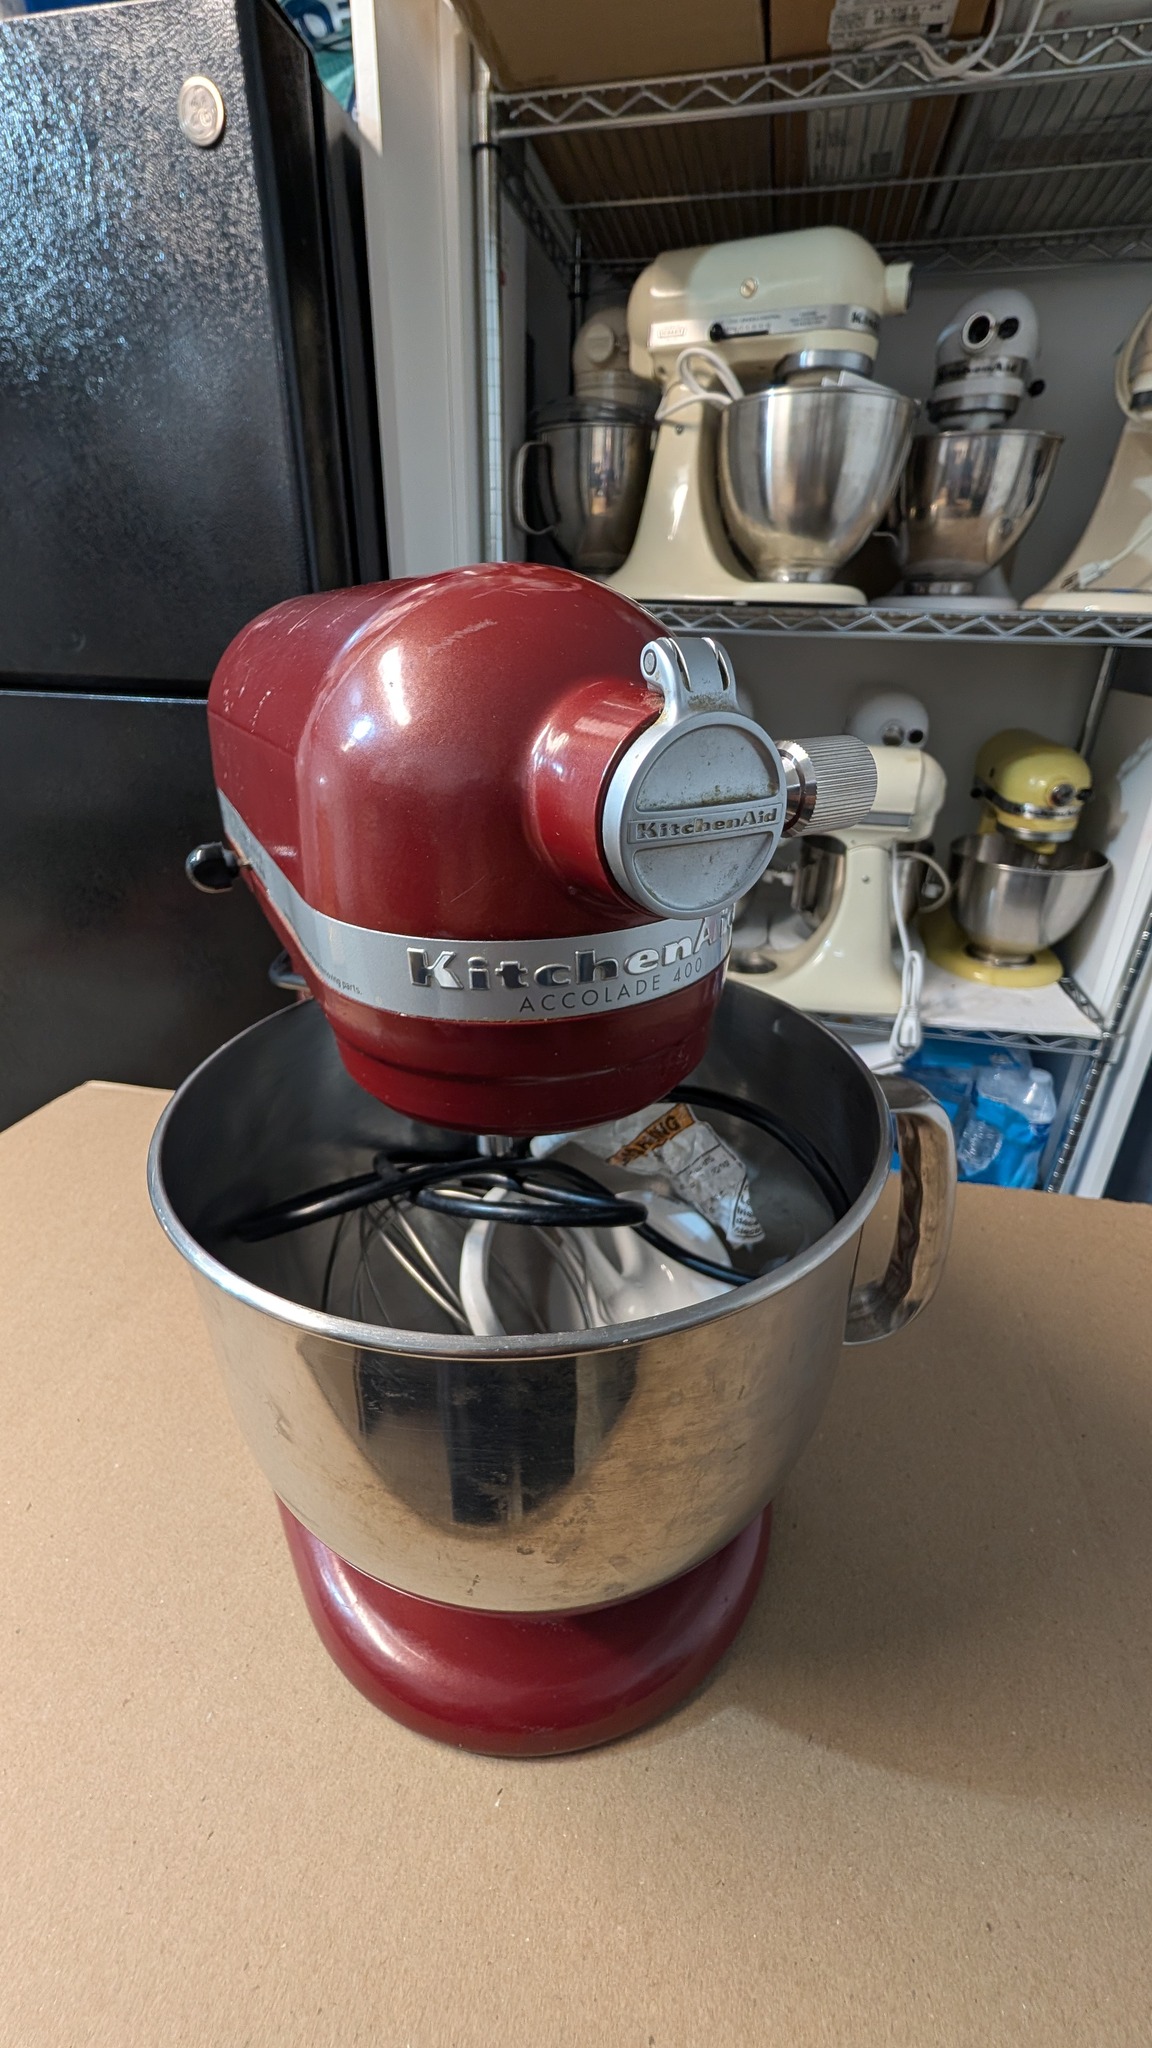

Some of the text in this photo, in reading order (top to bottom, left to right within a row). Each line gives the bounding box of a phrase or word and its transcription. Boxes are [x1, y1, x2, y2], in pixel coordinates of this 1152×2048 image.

[636, 808, 778, 840] KitchenAid
[519, 957, 702, 1013] ACCOLADE 400
